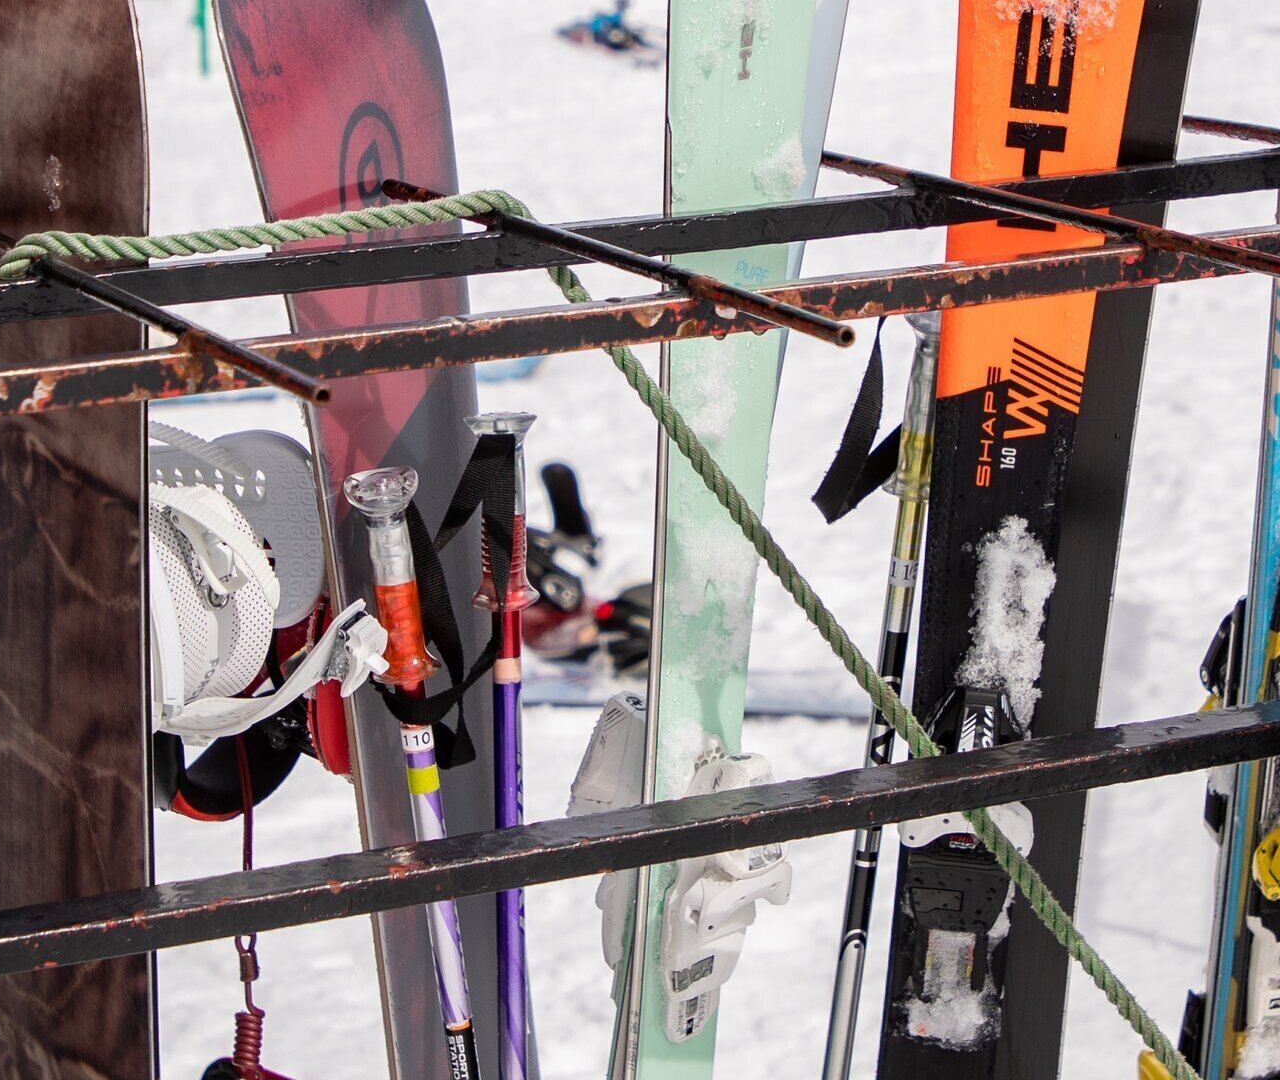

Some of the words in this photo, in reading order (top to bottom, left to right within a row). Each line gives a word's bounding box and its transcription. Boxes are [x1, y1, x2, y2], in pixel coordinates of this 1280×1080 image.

[976, 366, 1002, 488] SHAPE
[1000, 447, 1017, 470] 160
[403, 732, 431, 747] 110
[455, 1035, 470, 1080] SPORT
